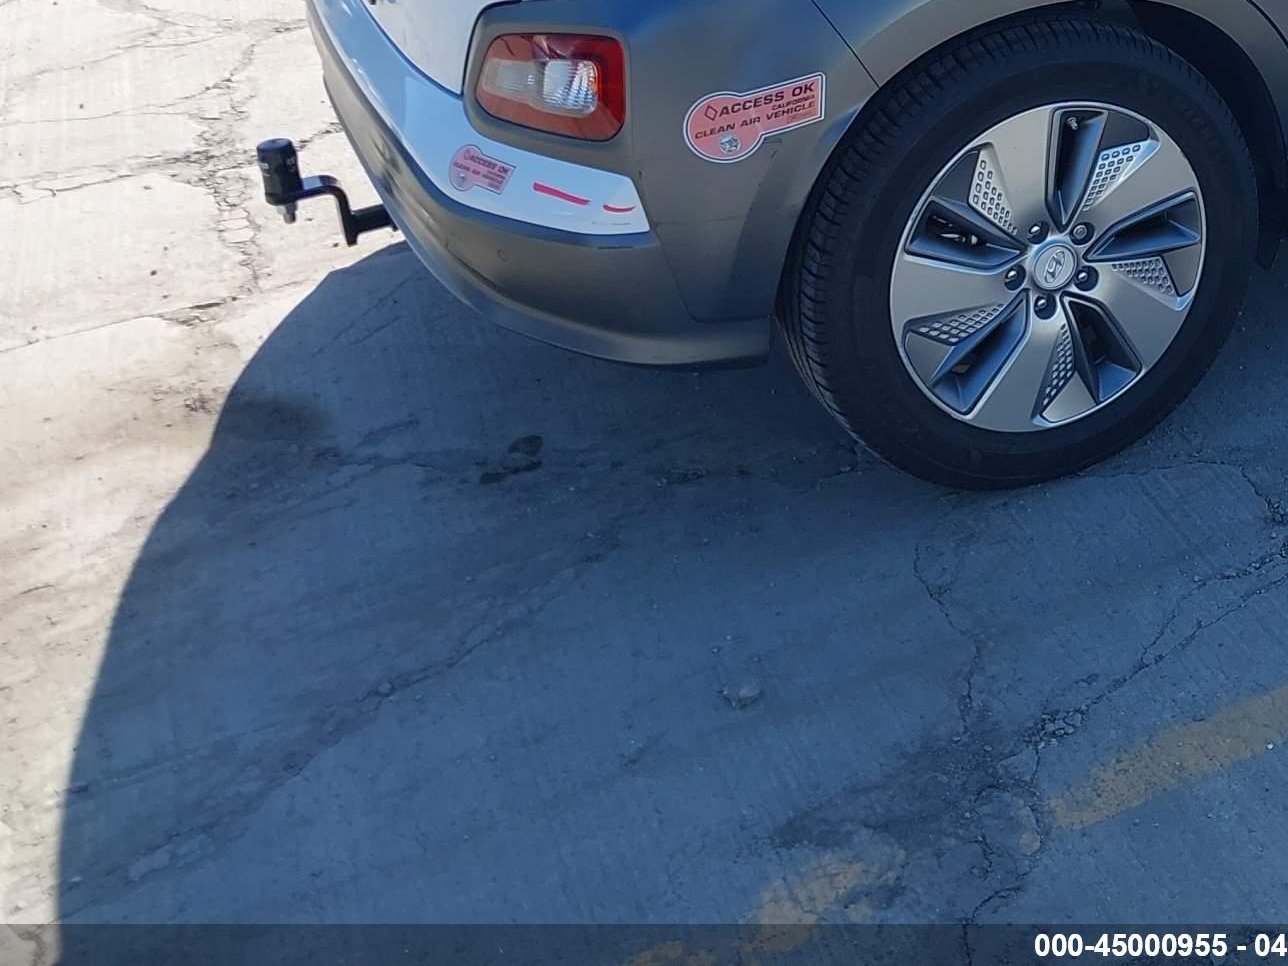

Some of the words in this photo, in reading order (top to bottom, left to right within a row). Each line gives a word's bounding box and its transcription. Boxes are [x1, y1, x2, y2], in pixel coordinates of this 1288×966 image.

[719, 91, 785, 117] ACCESS
[792, 82, 815, 97] OK
[771, 94, 815, 111] CALIFORNIA
[694, 123, 736, 139] CLEAN
[740, 116, 761, 128] AIR
[766, 101, 815, 121] VEHICLE
